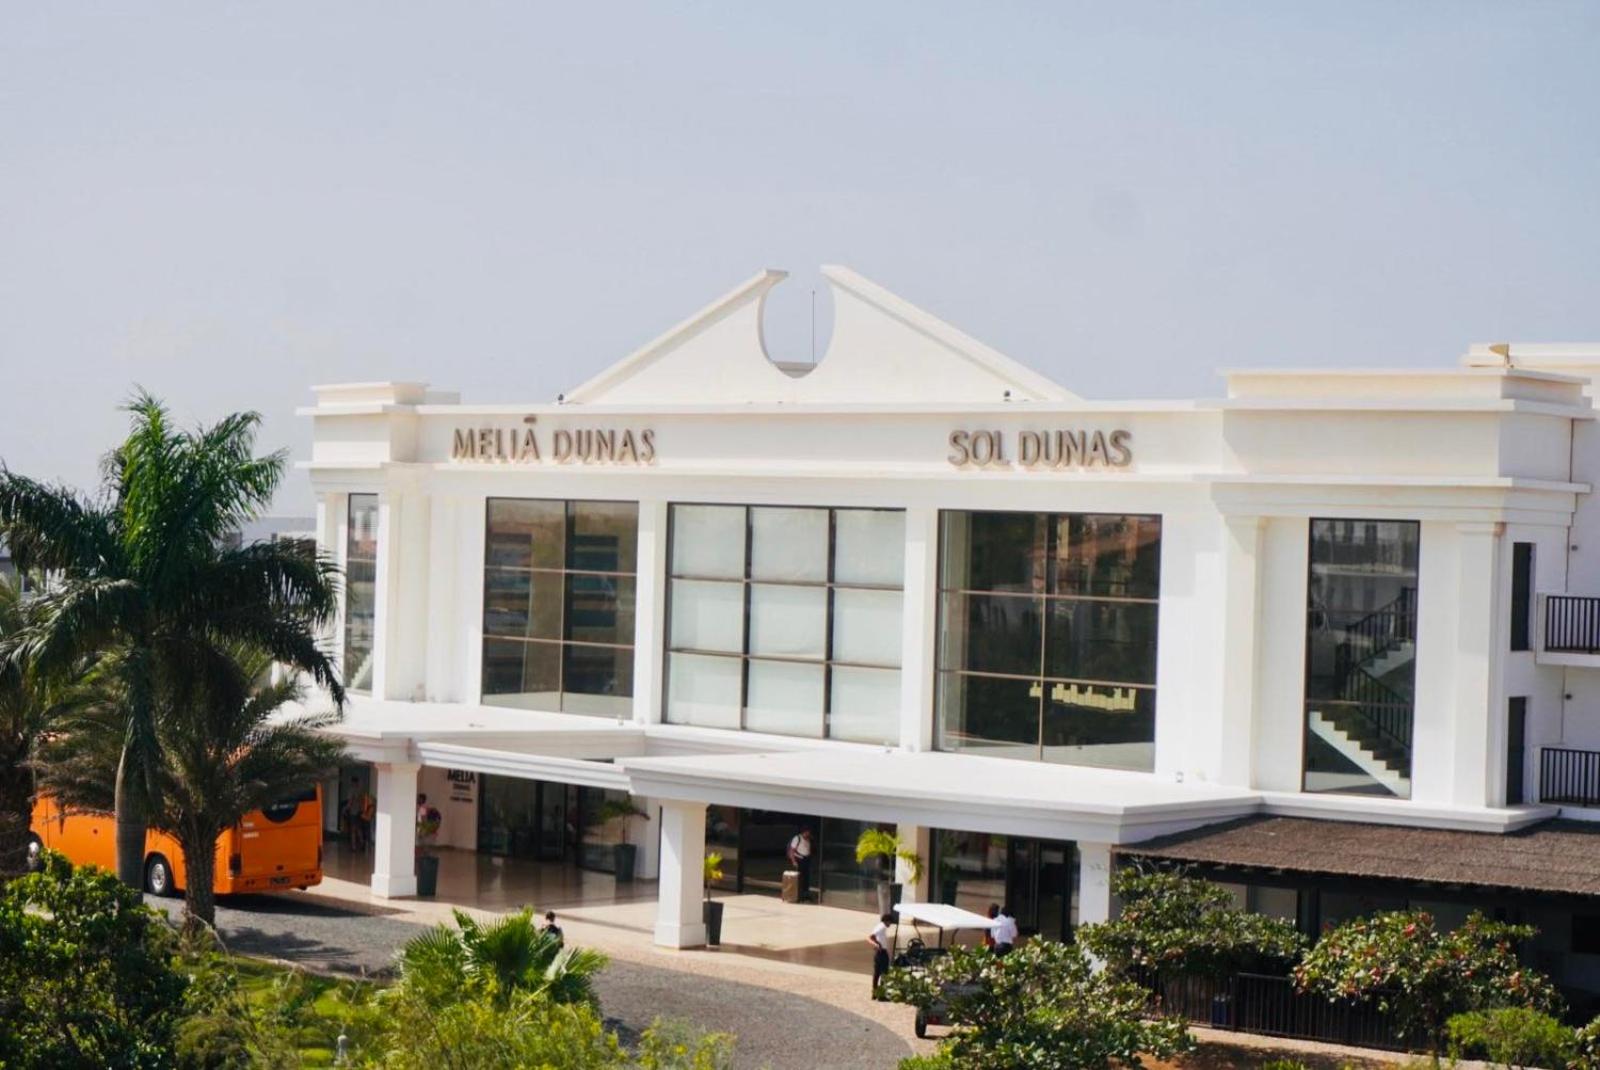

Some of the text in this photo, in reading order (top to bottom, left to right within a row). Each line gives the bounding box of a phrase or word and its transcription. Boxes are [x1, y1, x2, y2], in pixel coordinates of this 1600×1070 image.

[552, 428, 656, 464] DUNAS
[948, 429, 1133, 468] SOL DUNAS
